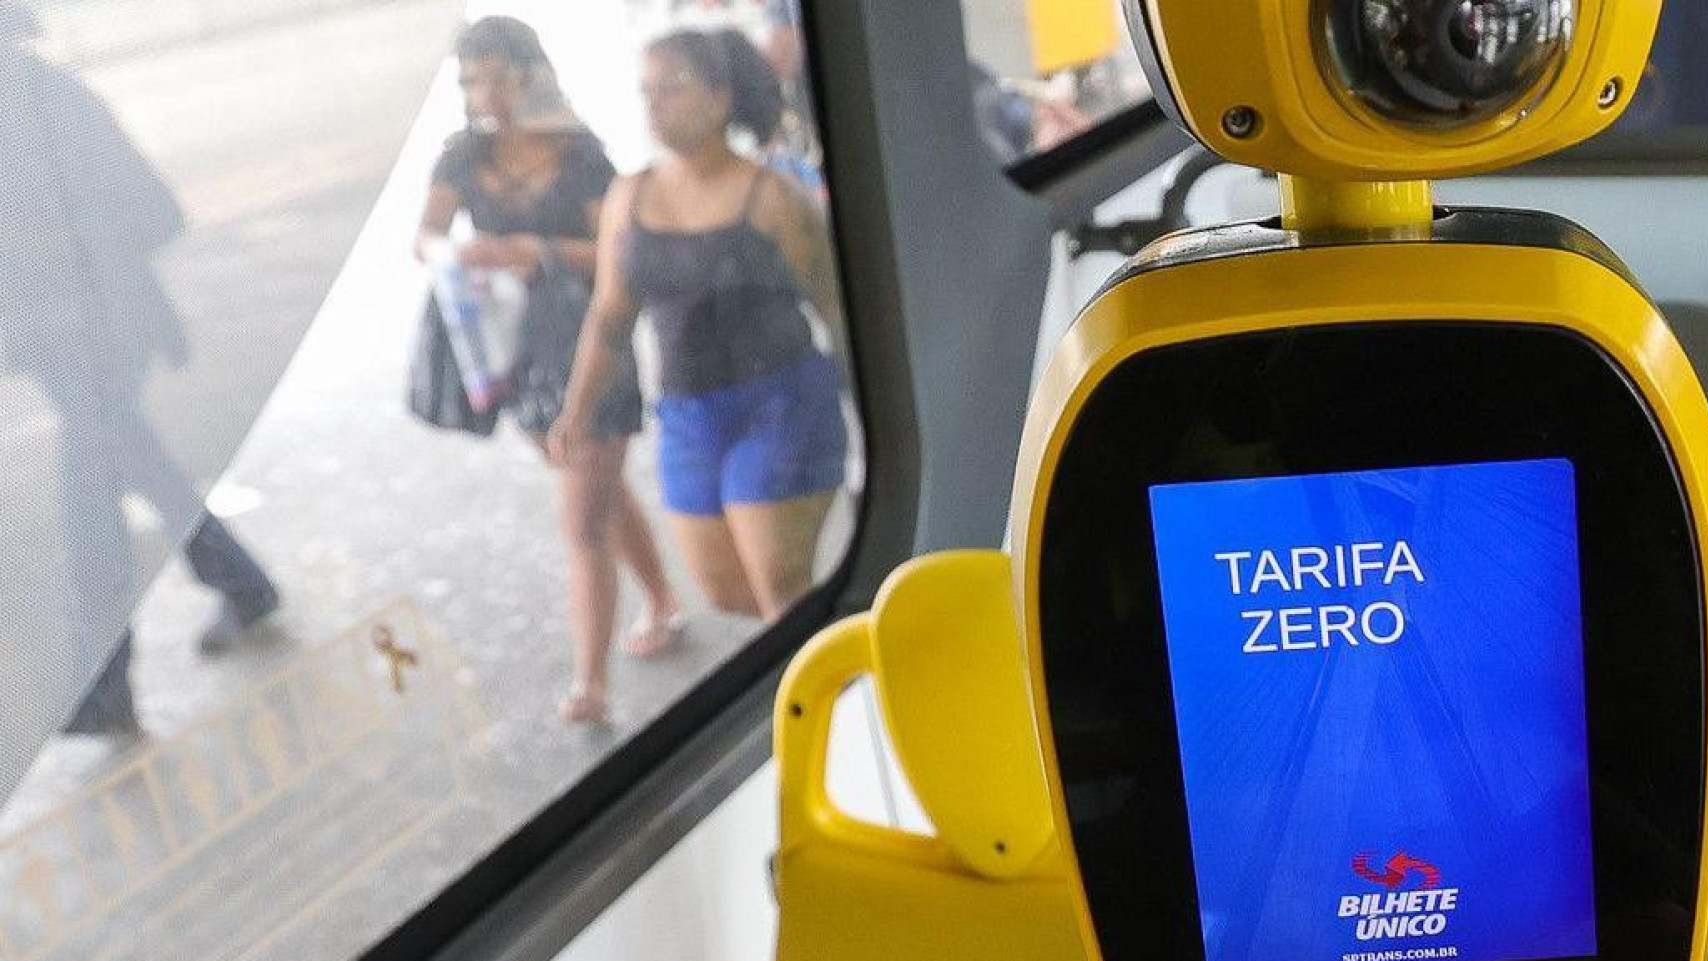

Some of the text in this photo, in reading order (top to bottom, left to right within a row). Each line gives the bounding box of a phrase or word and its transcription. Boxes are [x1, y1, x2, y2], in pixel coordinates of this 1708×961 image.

[1214, 540, 1425, 595] TARIFA
[1240, 601, 1405, 653] ZERO
[1338, 888, 1459, 917] BILHETE
[1355, 912, 1446, 941] ÚNICO
